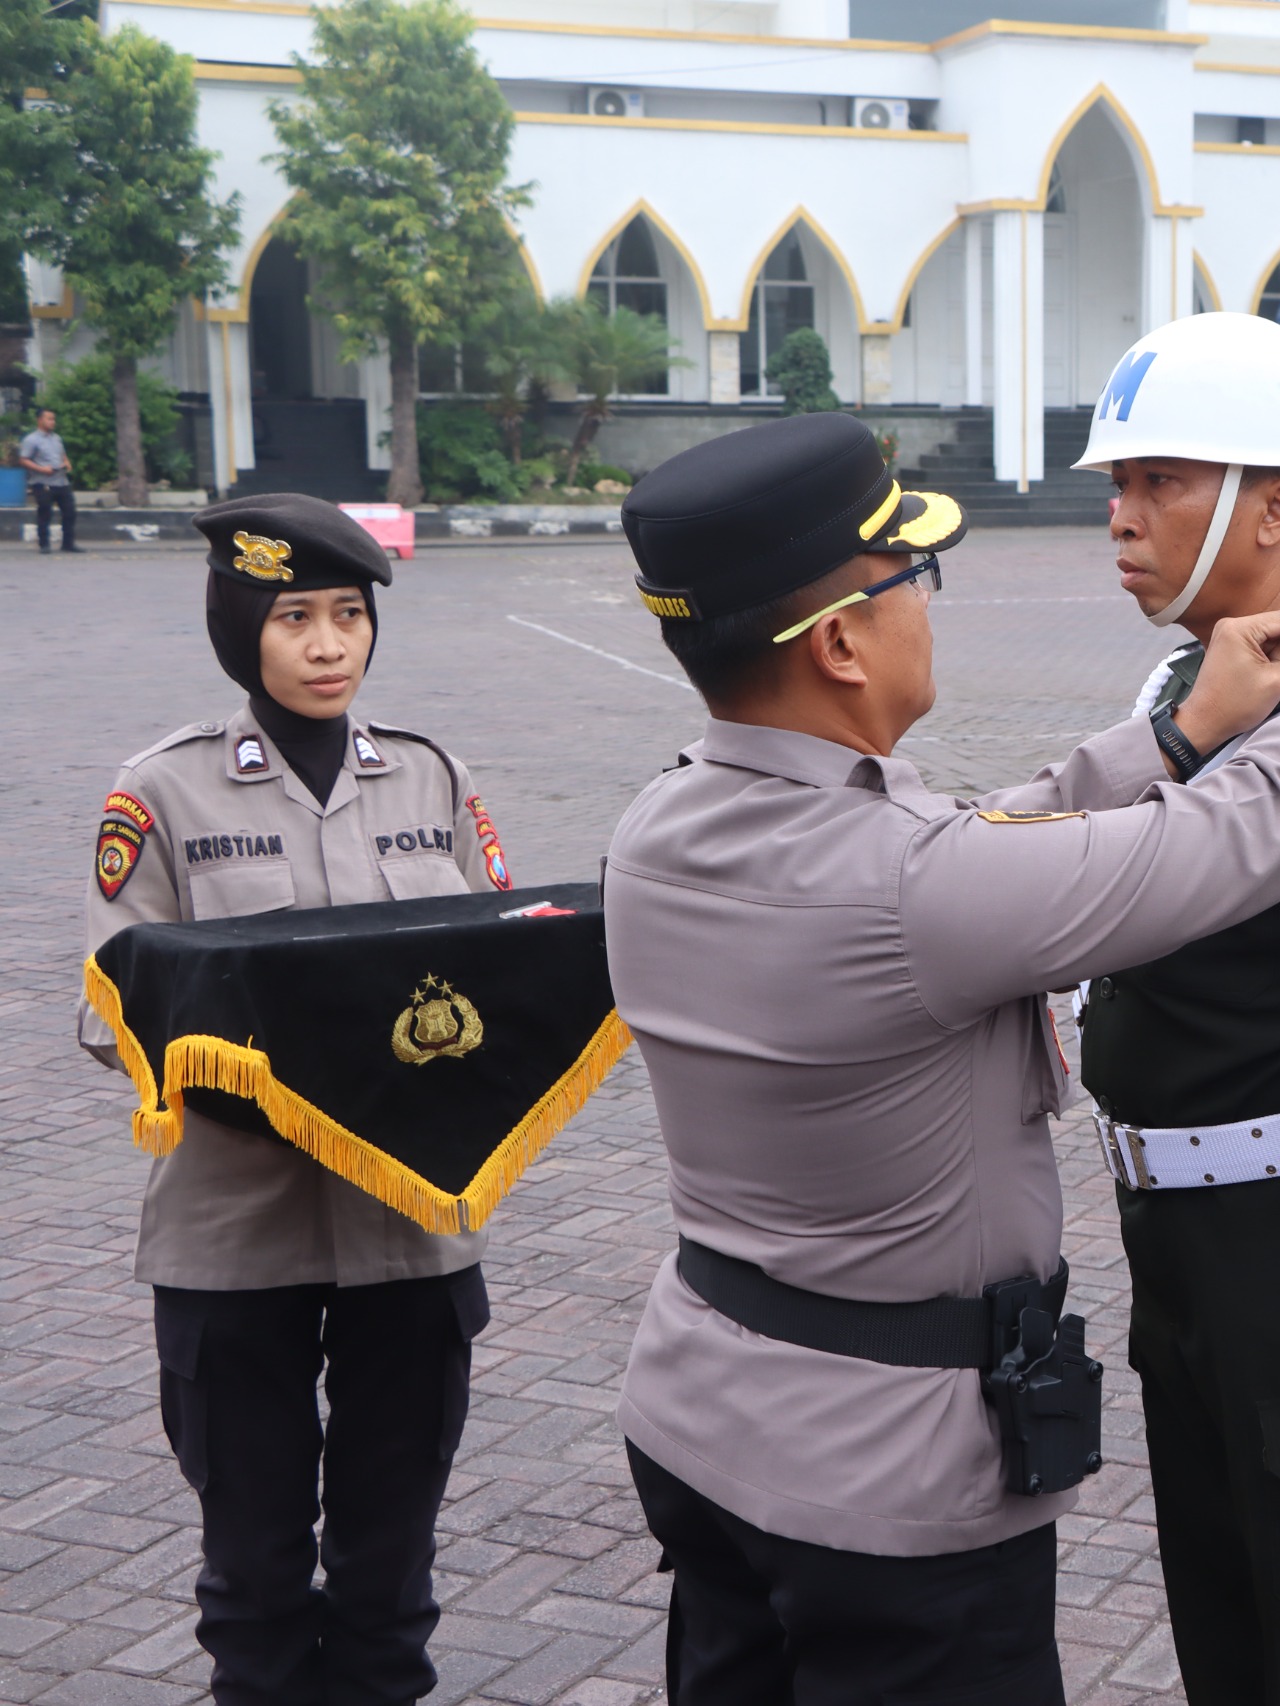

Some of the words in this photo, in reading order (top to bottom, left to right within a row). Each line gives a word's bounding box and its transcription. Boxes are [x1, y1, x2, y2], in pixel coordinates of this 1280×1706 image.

[1099, 351, 1158, 422] M
[185, 834, 284, 864] KRISTIAN
[375, 828, 453, 856] POLRI
